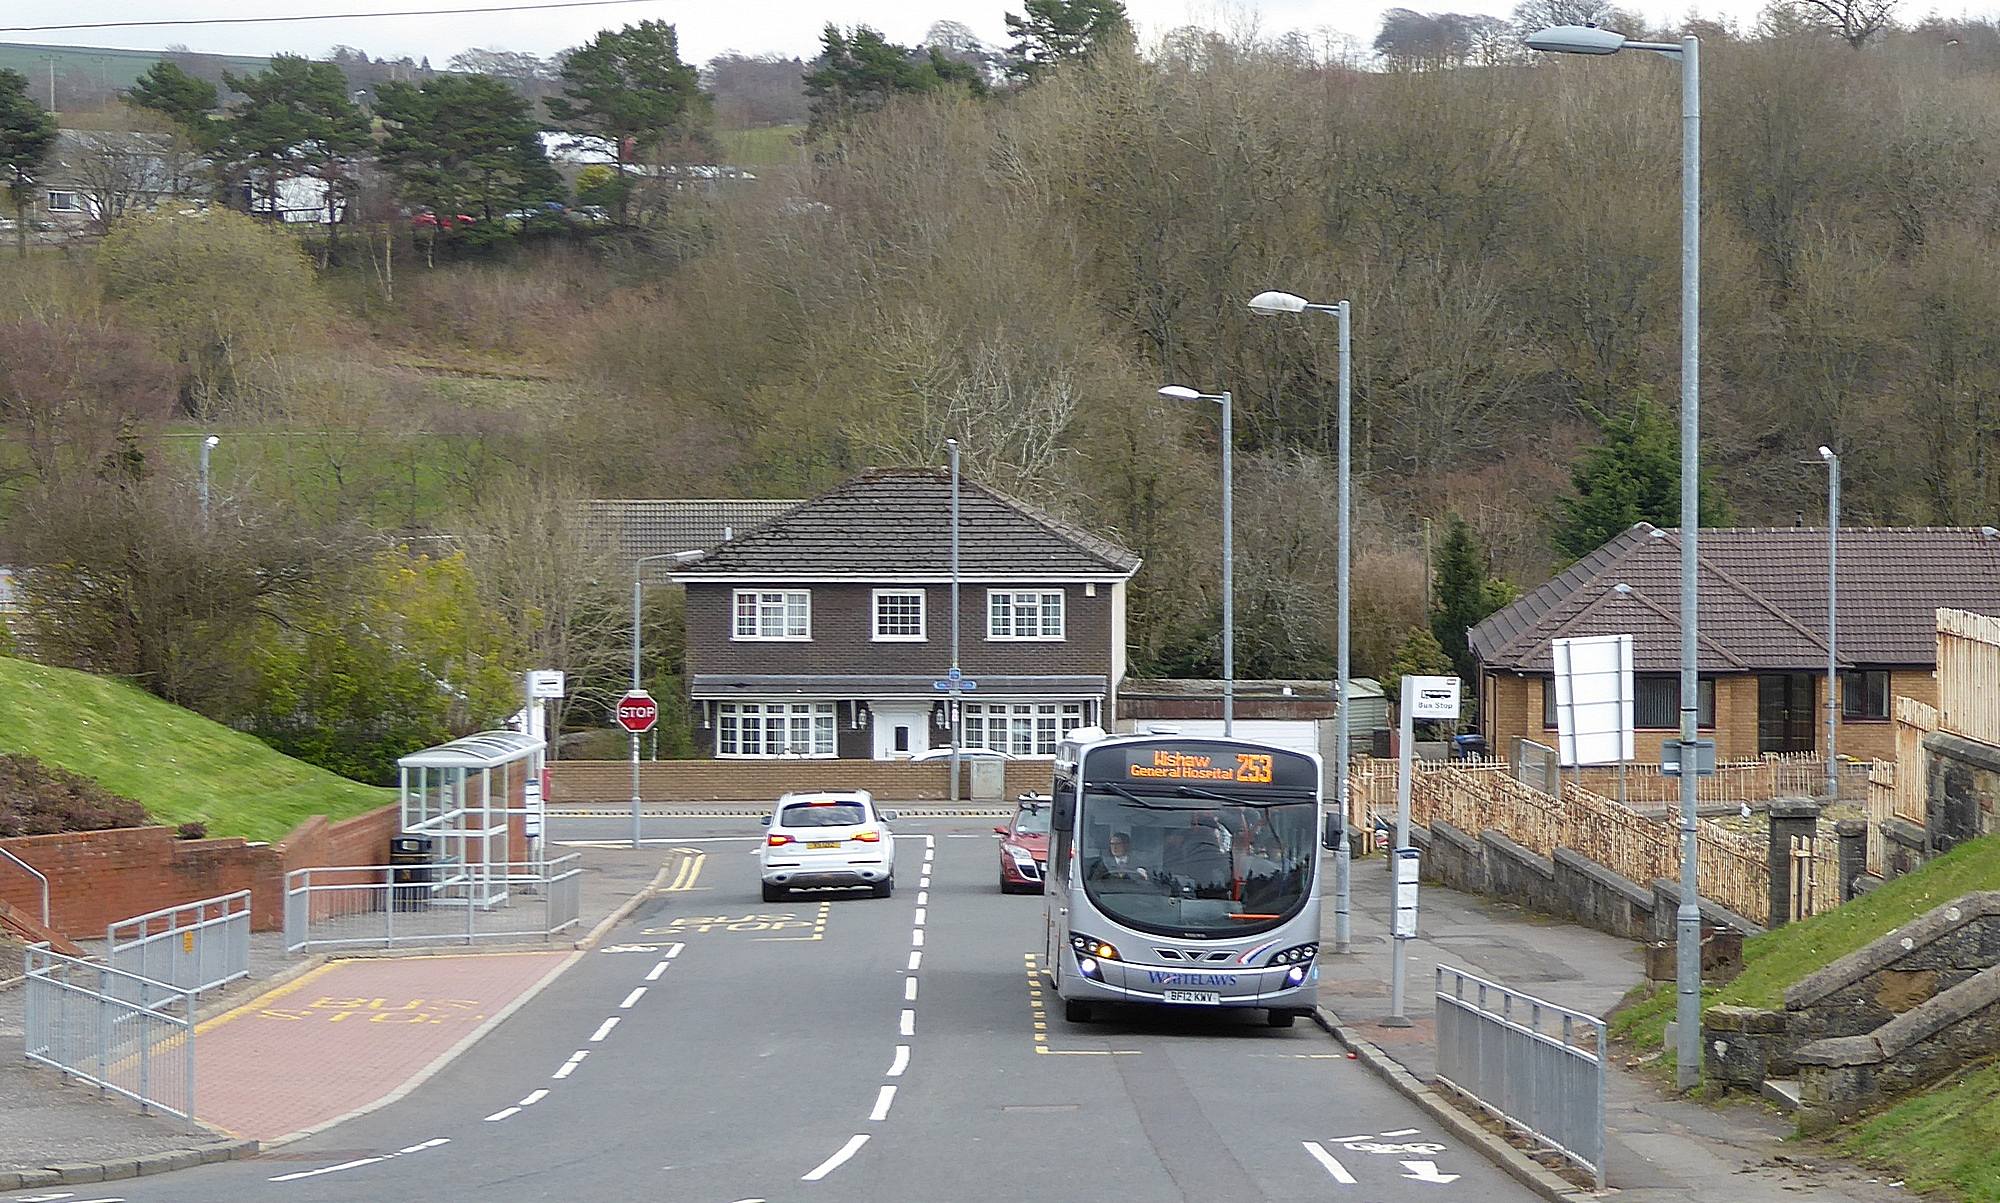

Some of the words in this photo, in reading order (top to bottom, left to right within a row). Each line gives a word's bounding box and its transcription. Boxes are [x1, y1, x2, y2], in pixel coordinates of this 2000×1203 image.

[620, 707, 655, 719] STOP
[1435, 702, 1453, 710] Stop
[1154, 750, 1211, 767] Wishaw
[1130, 764, 1181, 778] General
[1182, 767, 1233, 780] Hospital
[1236, 753, 1273, 783] 253
[640, 921, 812, 935] STOP
[1170, 991, 1192, 1002] BF12
